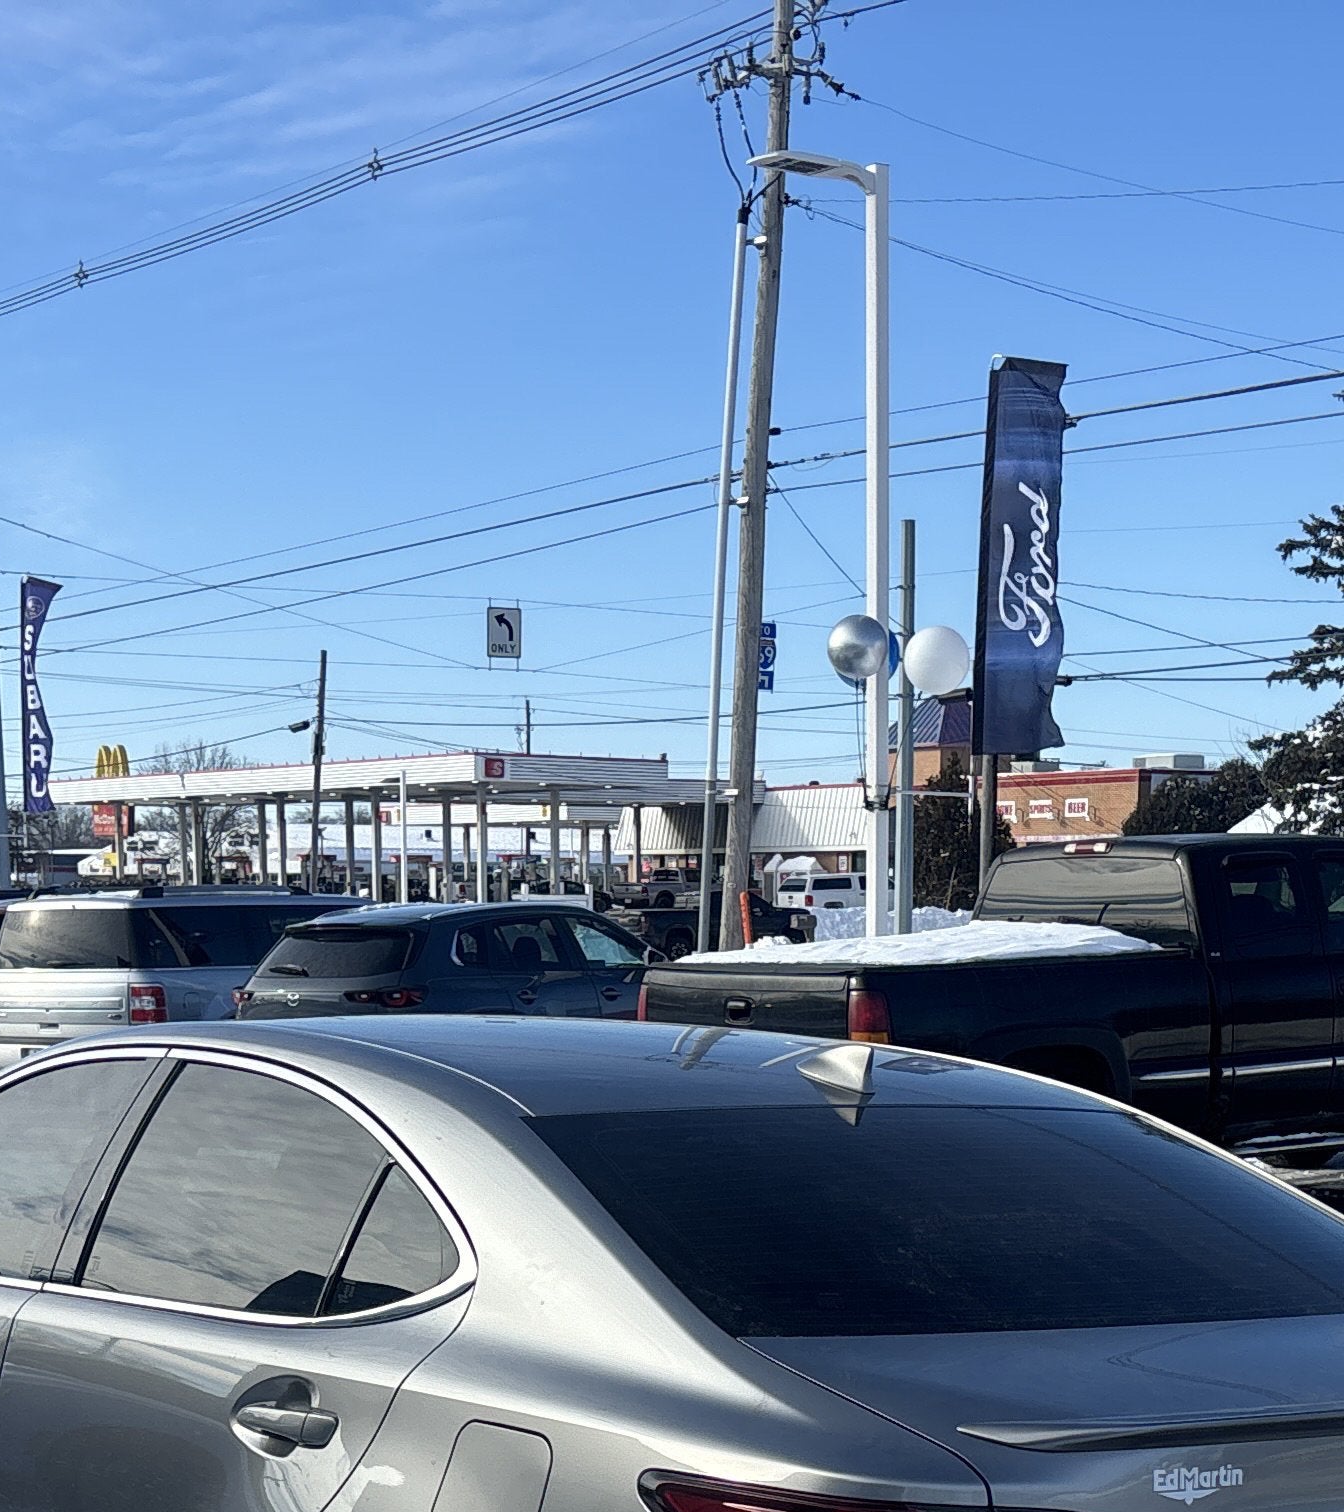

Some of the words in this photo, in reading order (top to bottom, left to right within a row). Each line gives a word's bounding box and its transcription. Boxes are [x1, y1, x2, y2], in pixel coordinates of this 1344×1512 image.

[998, 481, 1055, 648] Ford
[490, 643, 517, 654] ONLY
[23, 624, 49, 798] SUBARU
[1067, 801, 1087, 814] BEER
[1153, 1464, 1242, 1492] EdMartin
